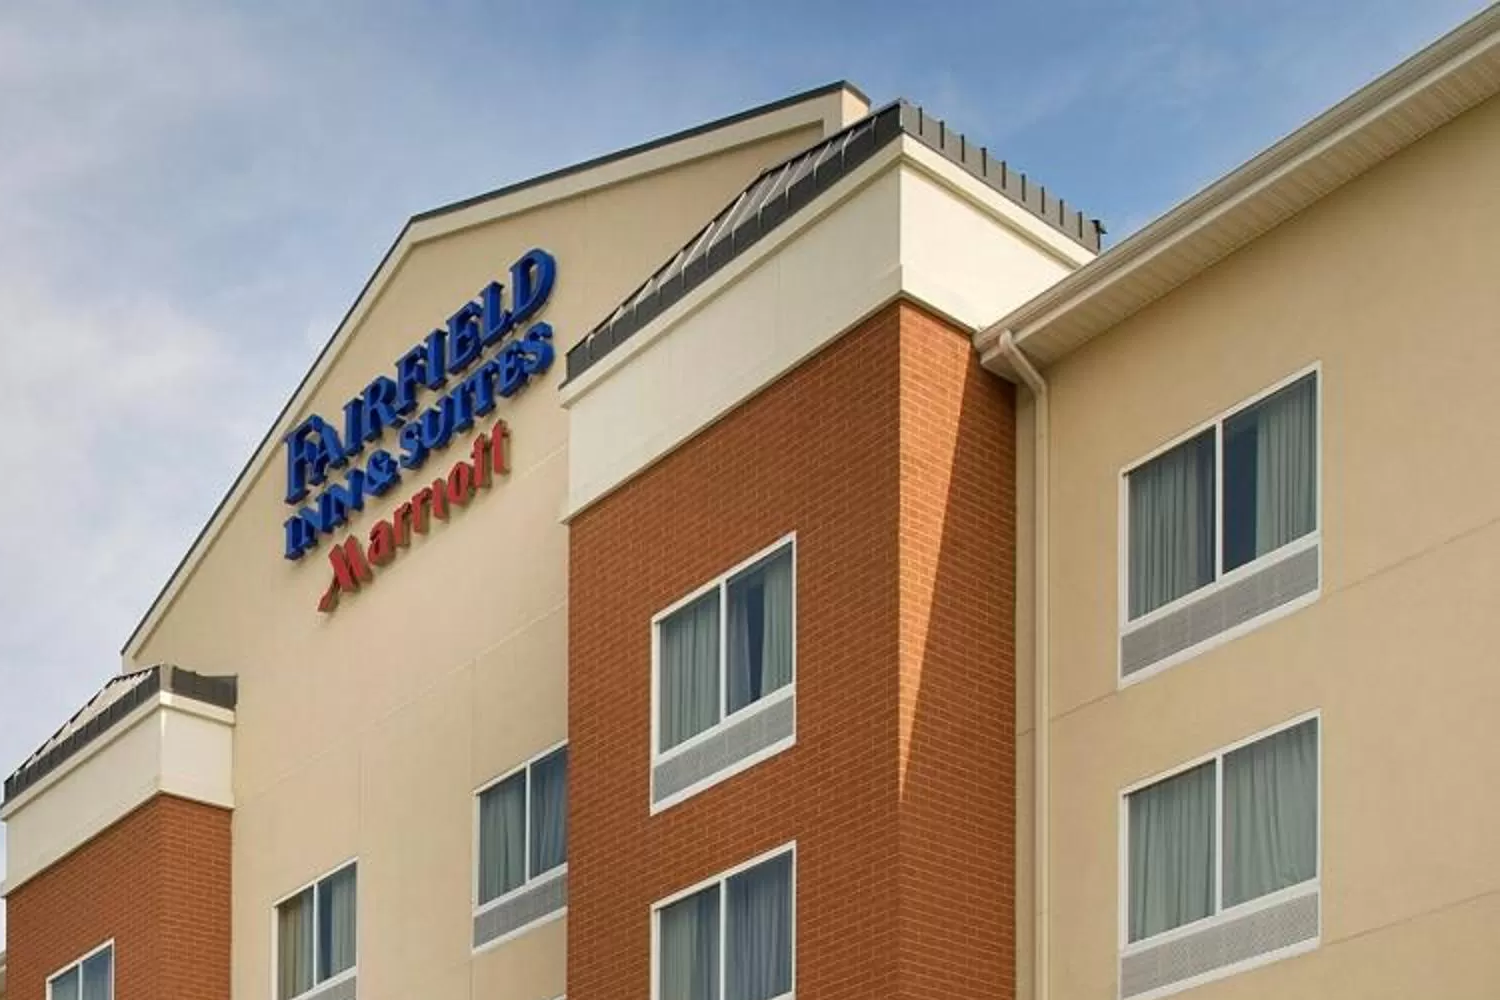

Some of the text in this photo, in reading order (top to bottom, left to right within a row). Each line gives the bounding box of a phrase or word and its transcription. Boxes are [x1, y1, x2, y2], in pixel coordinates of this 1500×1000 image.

[284, 248, 556, 504] FAIRFIELD
[284, 321, 555, 560] INN & SUITES
[317, 418, 511, 612] Marriott
